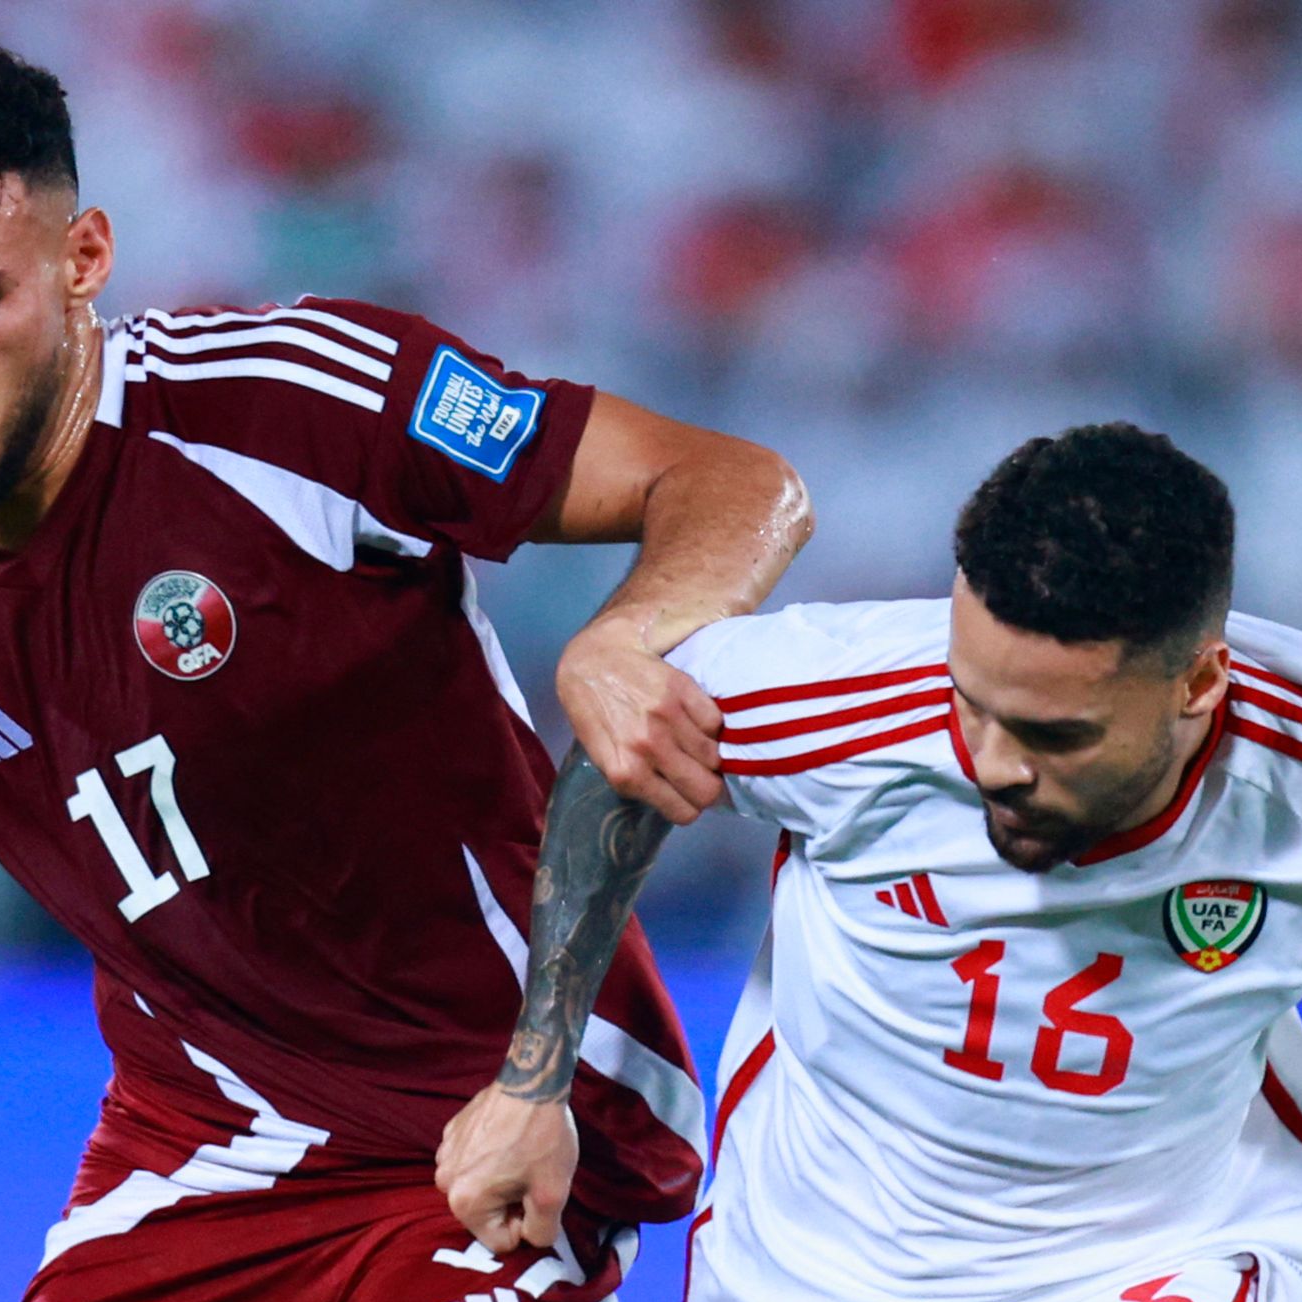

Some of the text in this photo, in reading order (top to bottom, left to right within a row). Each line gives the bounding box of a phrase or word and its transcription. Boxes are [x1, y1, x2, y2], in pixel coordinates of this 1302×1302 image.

[431, 372, 465, 426] FOOTBALL
[445, 380, 483, 435] UNITES
[66, 733, 211, 924] 17
[1192, 903, 1239, 918] UAE
[1201, 920, 1226, 931] FA
[943, 939, 1134, 1096] 16
